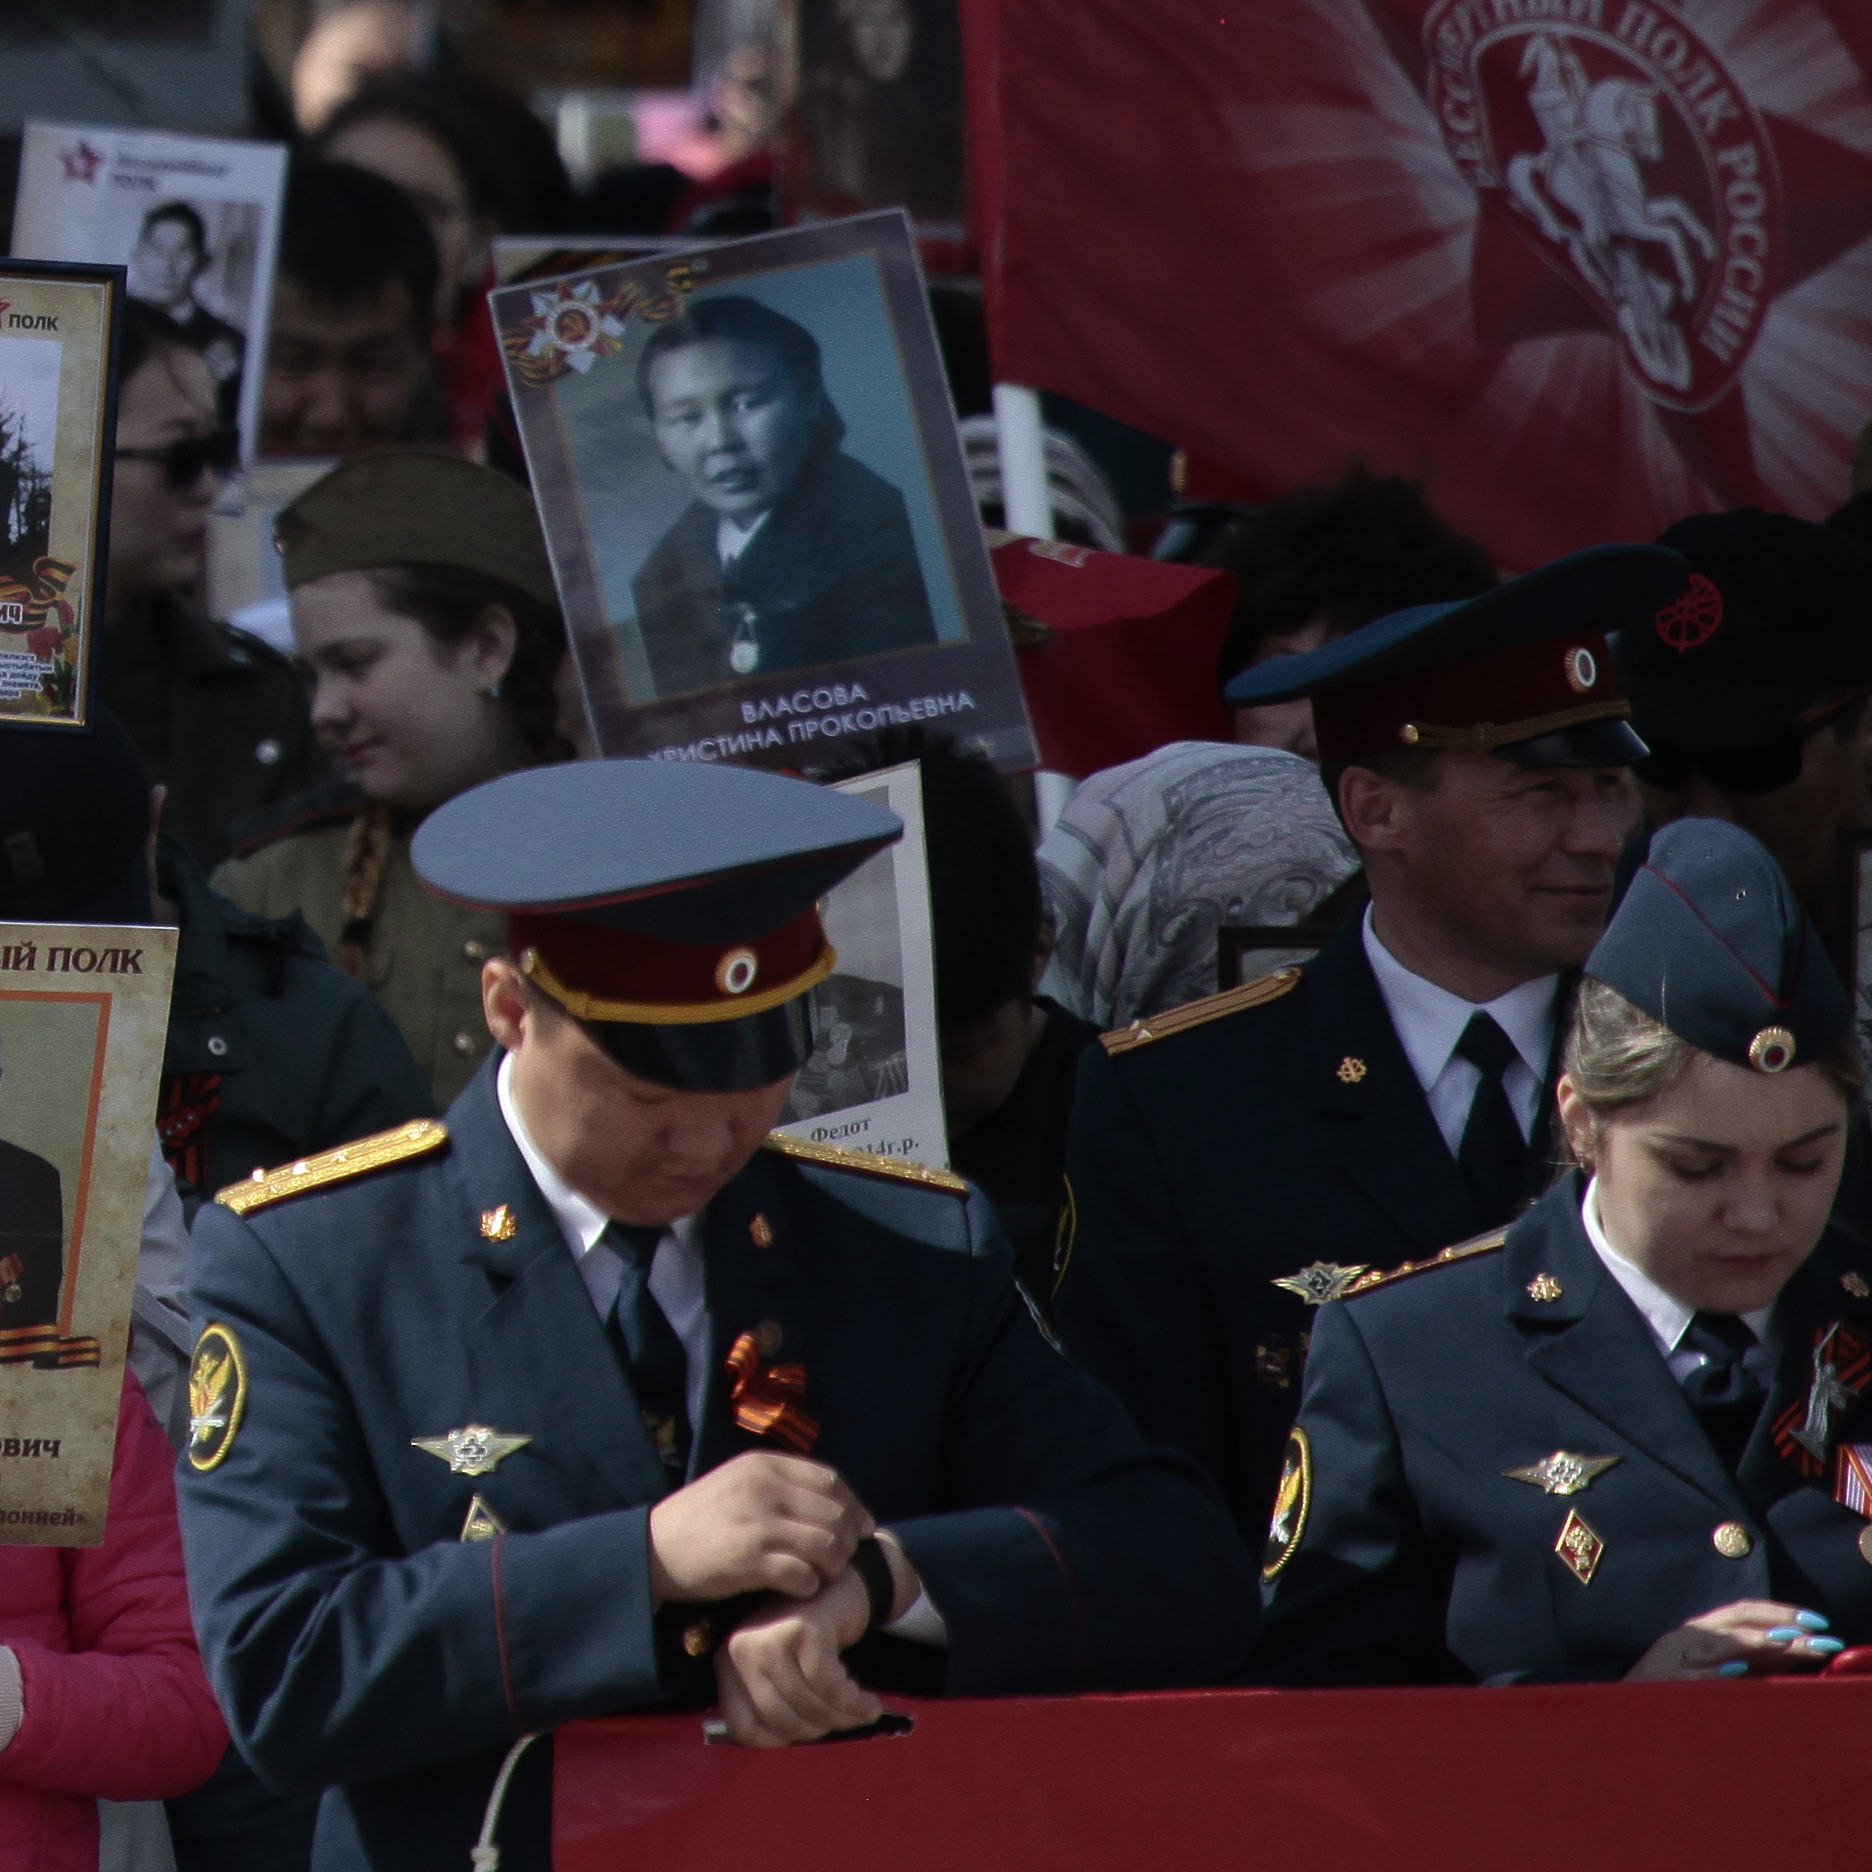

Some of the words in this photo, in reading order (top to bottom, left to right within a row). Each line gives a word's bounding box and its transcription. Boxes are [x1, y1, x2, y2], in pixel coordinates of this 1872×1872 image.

[1618, 1, 1740, 135] ПОЛК
[1699, 140, 1769, 364] РОССИИ
[9, 314, 59, 331] ПОЛК
[740, 681, 870, 724] ВЛАСОВА
[787, 689, 976, 743] ПРОКОПЬЕВНА
[46, 946, 144, 974] ПОЛК
[810, 1118, 872, 1143] Федот
